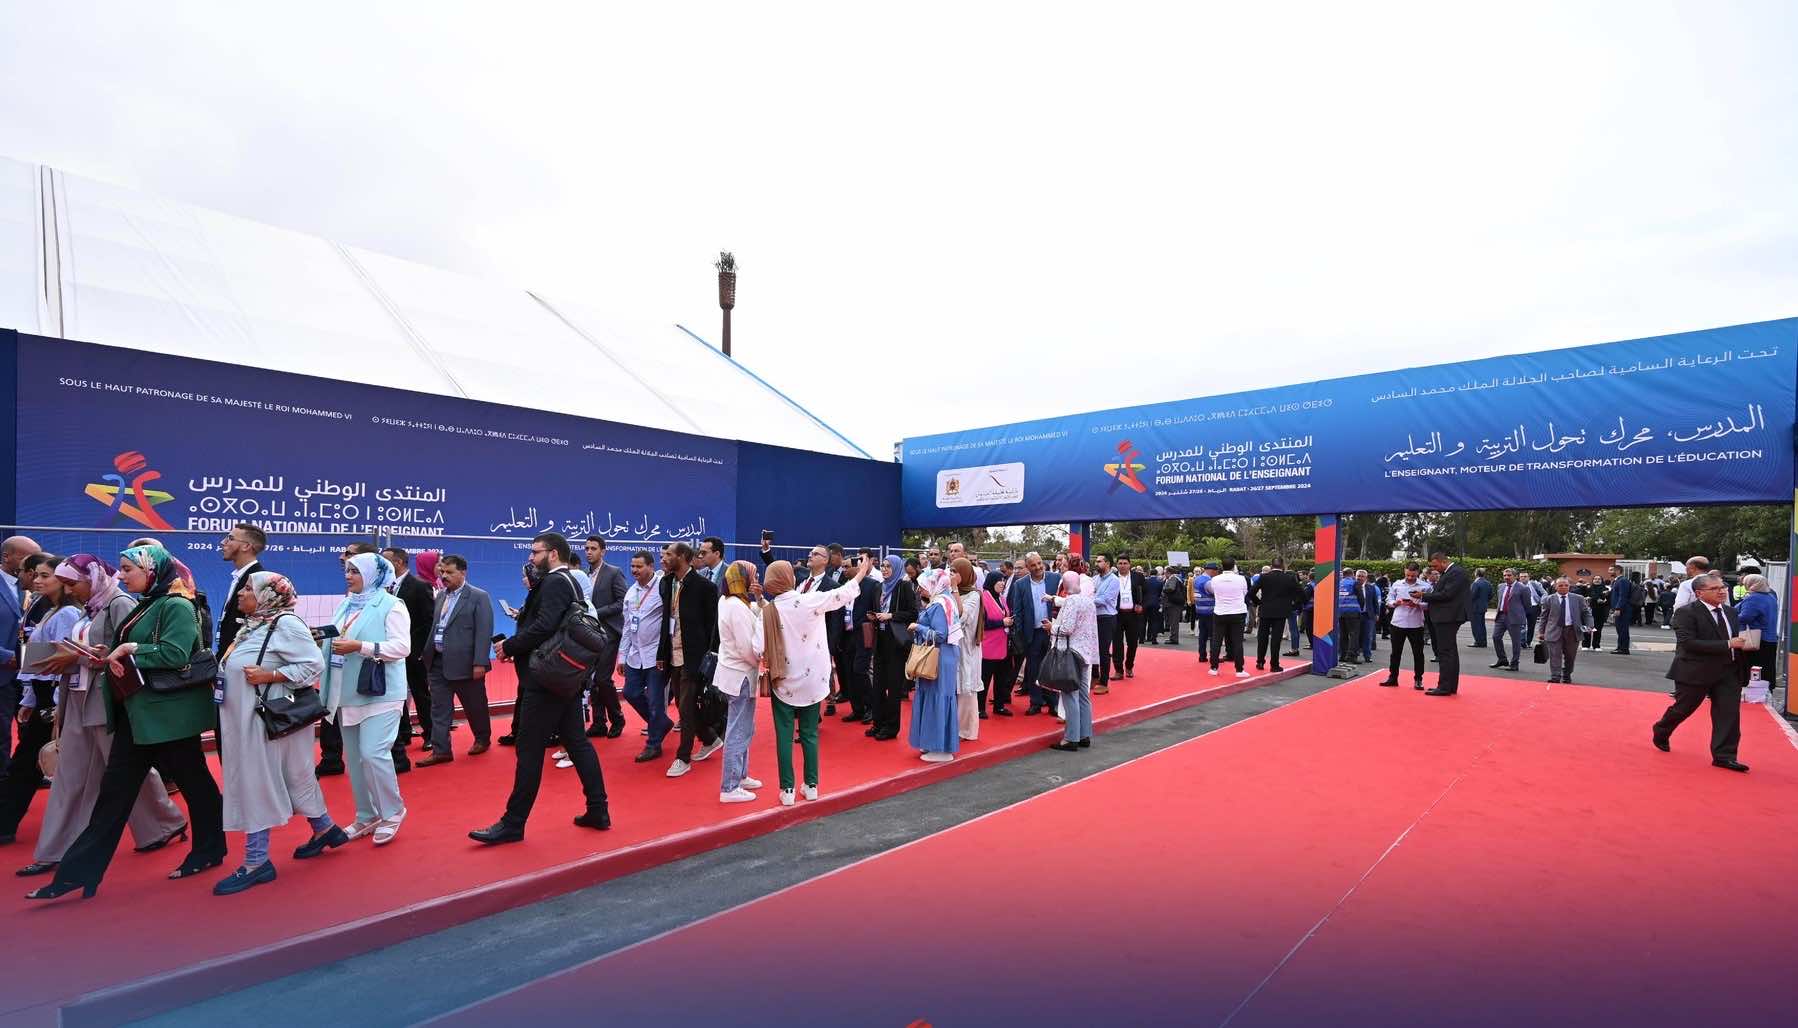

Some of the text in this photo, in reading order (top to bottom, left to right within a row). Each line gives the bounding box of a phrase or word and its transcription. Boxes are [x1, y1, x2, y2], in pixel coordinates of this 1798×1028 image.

[1371, 346, 1778, 403] تحت الرعاية السامية لصاحب الجلالة الملك محمد السادس
[60, 377, 88, 388] SOUS
[91, 381, 102, 390] LE
[105, 383, 133, 393] HAUT
[136, 386, 194, 401] PATRONAGE
[196, 394, 208, 402] DE
[211, 396, 222, 404] SA
[224, 398, 262, 409] MAJESTÉ
[275, 404, 290, 413] ROI
[292, 406, 343, 419] MOHAMMED
[1384, 431, 1442, 462] التعليم
[1476, 424, 1526, 460] التربية
[1532, 421, 1586, 453] تحول
[1600, 416, 1654, 450] محرك
[1156, 435, 1312, 462] المنتدى الوطني للمدرس
[1445, 441, 1465, 457] و
[1155, 466, 1312, 485] FORUM NATIONAL DE L'ENSEIGNANT
[1385, 449, 1762, 478] L'ENSEIGNANT, MOTEUR DE TRANSFORMATION DE L'ÉDUCATION
[189, 476, 446, 503] المنتدى الوطني للمدرس
[330, 523, 349, 534] DE
[490, 506, 537, 533] التعليم
[539, 519, 555, 533] و
[561, 511, 595, 539] التربية
[634, 514, 661, 540] محرك
